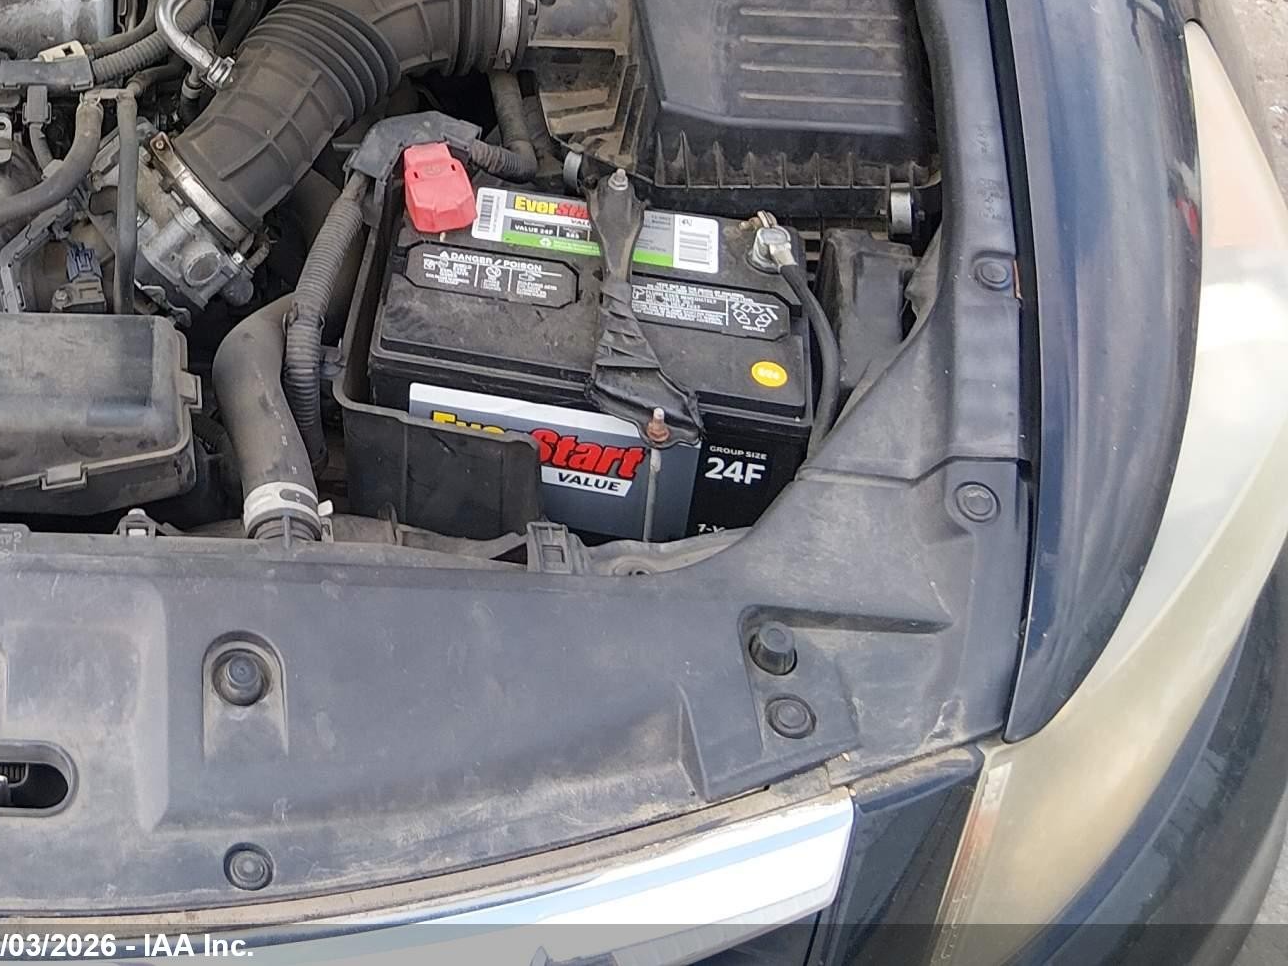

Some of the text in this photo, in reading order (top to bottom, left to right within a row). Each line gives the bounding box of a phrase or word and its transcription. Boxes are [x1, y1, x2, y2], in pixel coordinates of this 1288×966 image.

[451, 251, 493, 265] DANGER
[503, 259, 543, 272] POISON
[709, 445, 768, 461] GROUP SIZE
[557, 471, 621, 492] VALUE
[704, 457, 766, 485] 24F
